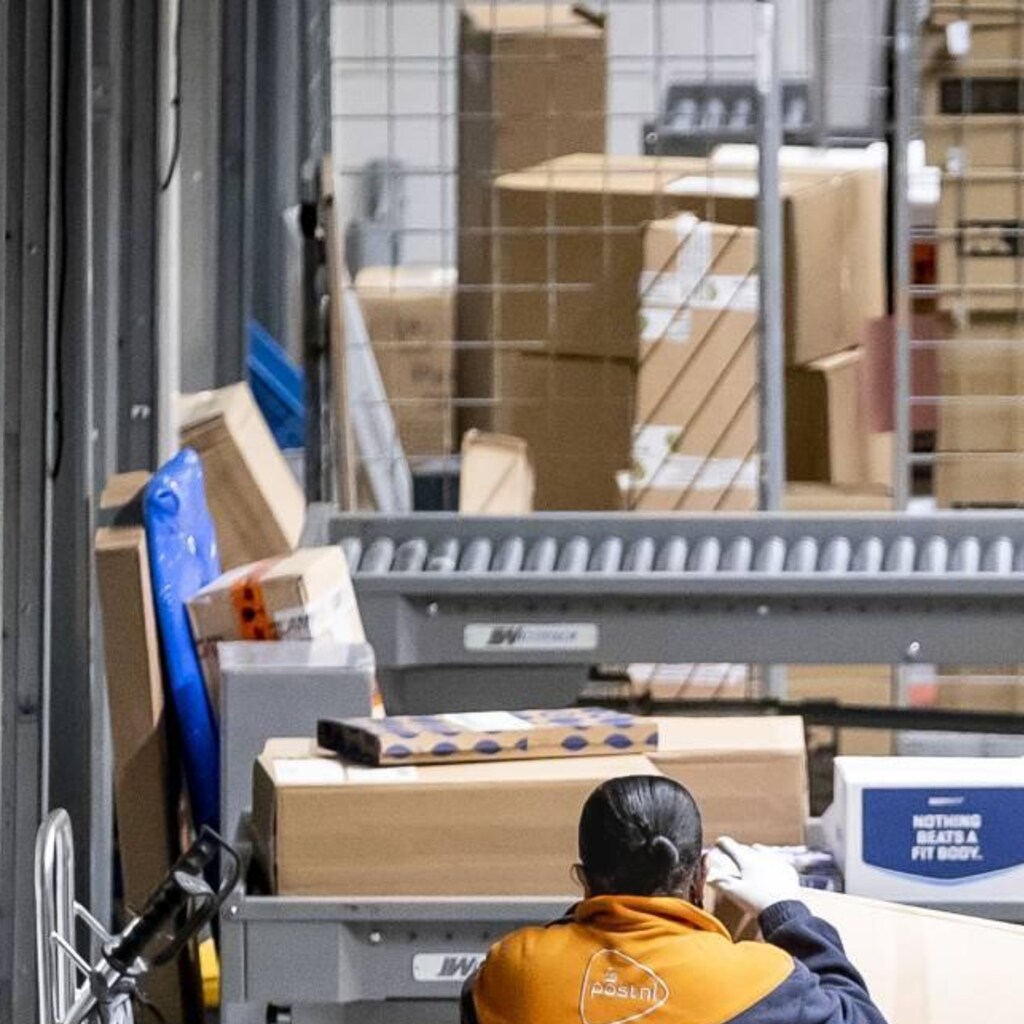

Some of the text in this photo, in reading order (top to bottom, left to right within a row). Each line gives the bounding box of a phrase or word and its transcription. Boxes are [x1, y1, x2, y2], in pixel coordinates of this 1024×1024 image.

[913, 814, 982, 828] NOTHING
[916, 830, 978, 844] BEATS A
[911, 846, 935, 861] FIT
